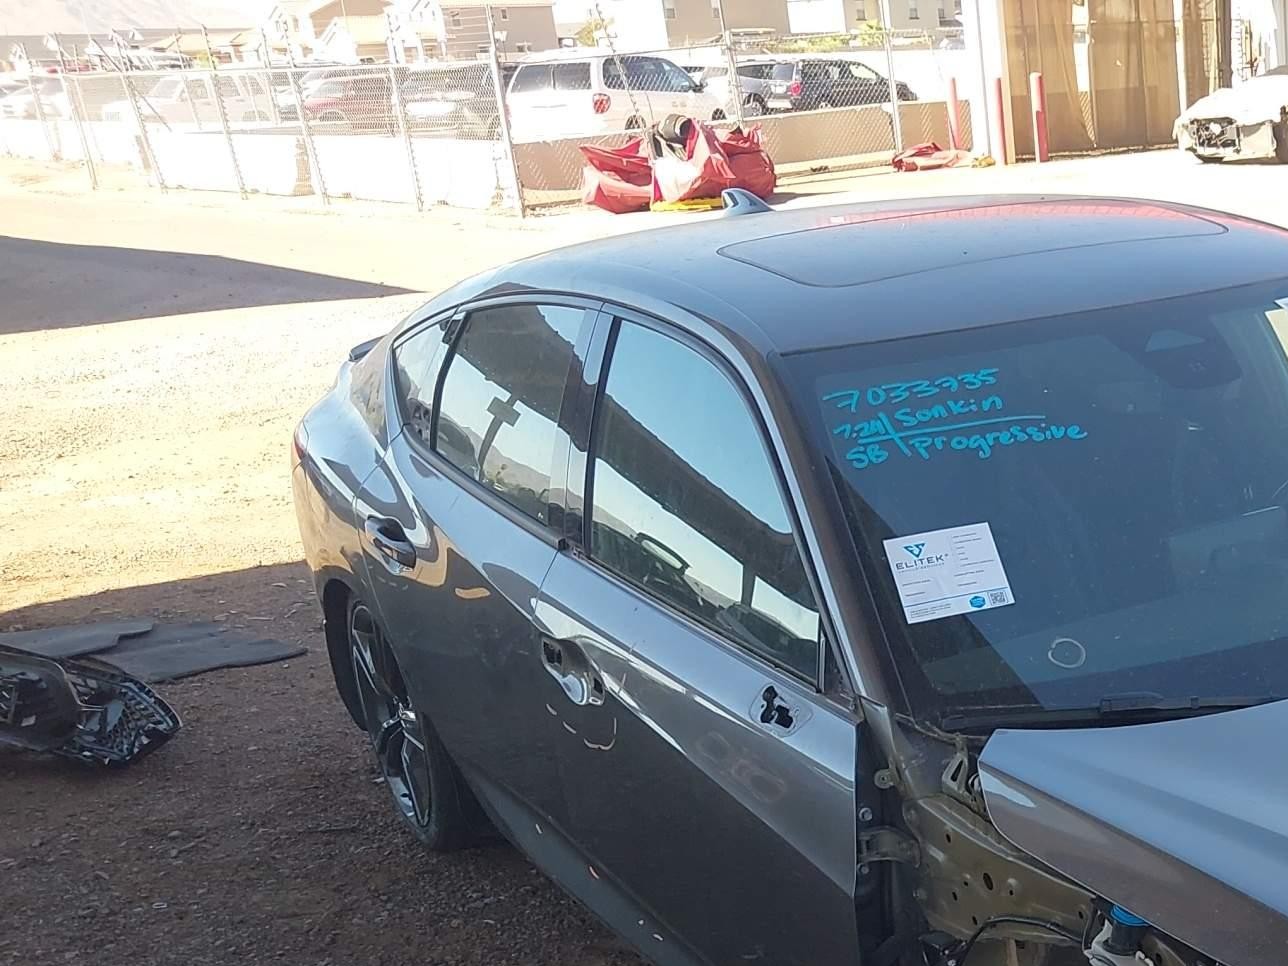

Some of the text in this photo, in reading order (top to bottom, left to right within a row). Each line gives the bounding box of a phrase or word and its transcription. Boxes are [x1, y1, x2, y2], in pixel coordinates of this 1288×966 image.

[823, 368, 999, 413] 7033735
[895, 396, 1003, 427] Sonkin
[896, 554, 944, 570] ELITEK
